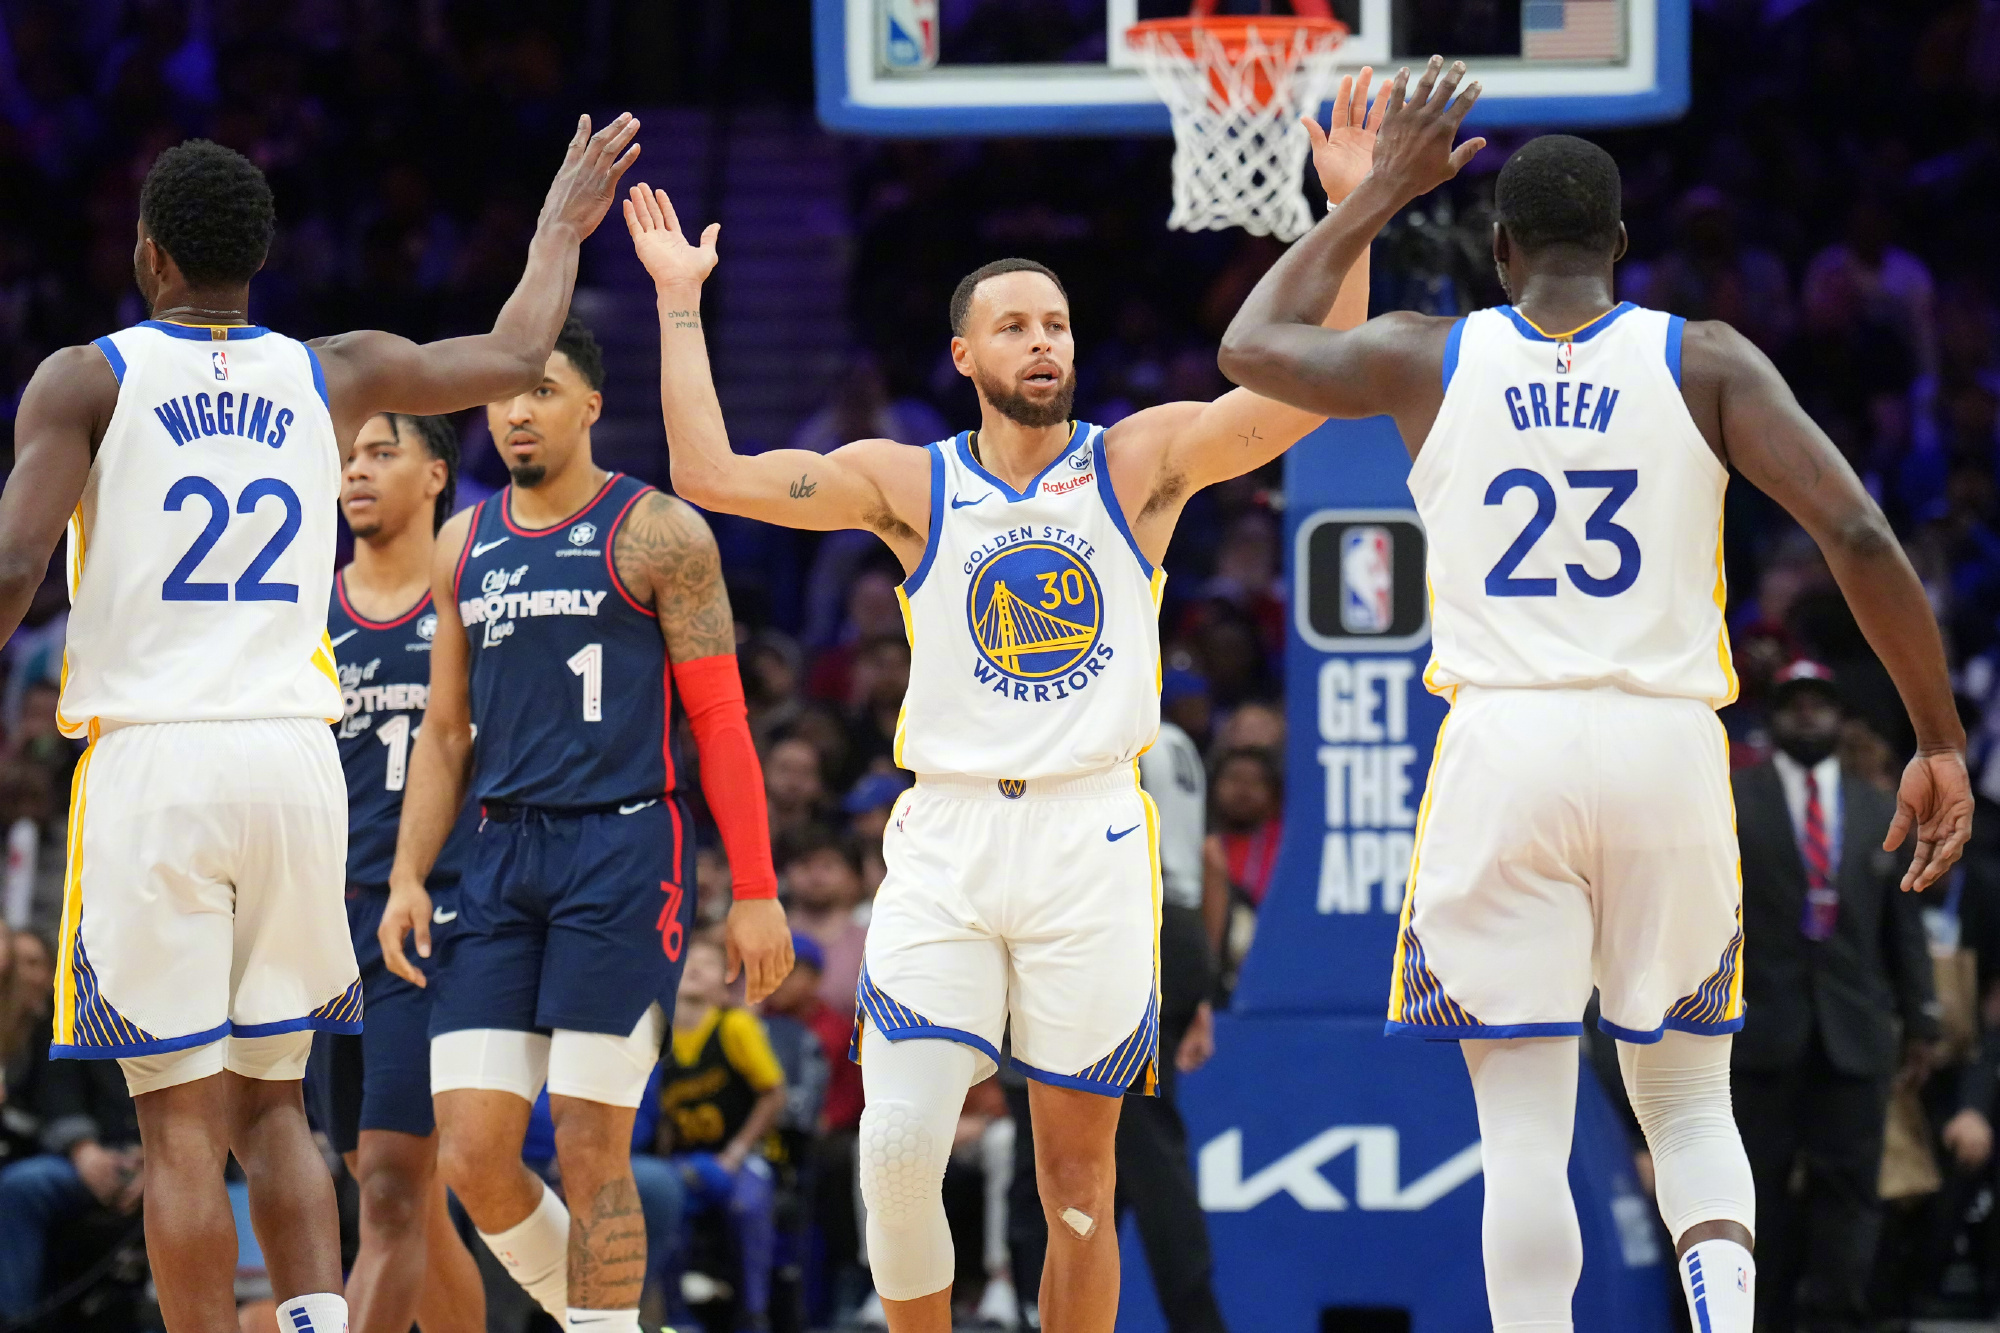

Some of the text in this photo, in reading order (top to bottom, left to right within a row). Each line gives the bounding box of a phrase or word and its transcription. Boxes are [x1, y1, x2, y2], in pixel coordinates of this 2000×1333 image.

[153, 391, 295, 449] WIGGINS
[1504, 381, 1620, 434] GREEN
[1042, 473, 1094, 494] Rakuten
[161, 475, 302, 604] 22
[963, 525, 1096, 575] GOLDEN STATE
[1483, 467, 1642, 598] 23
[459, 588, 608, 628] BROTHERLY
[1035, 568, 1085, 610] 30
[341, 683, 432, 716] OTHER
[566, 643, 603, 722] 1
[973, 642, 1114, 703] WARRIORS
[1317, 658, 1416, 744] GET
[1316, 743, 1418, 830] THE
[1316, 830, 1416, 915] APP
[655, 880, 684, 963] 76
